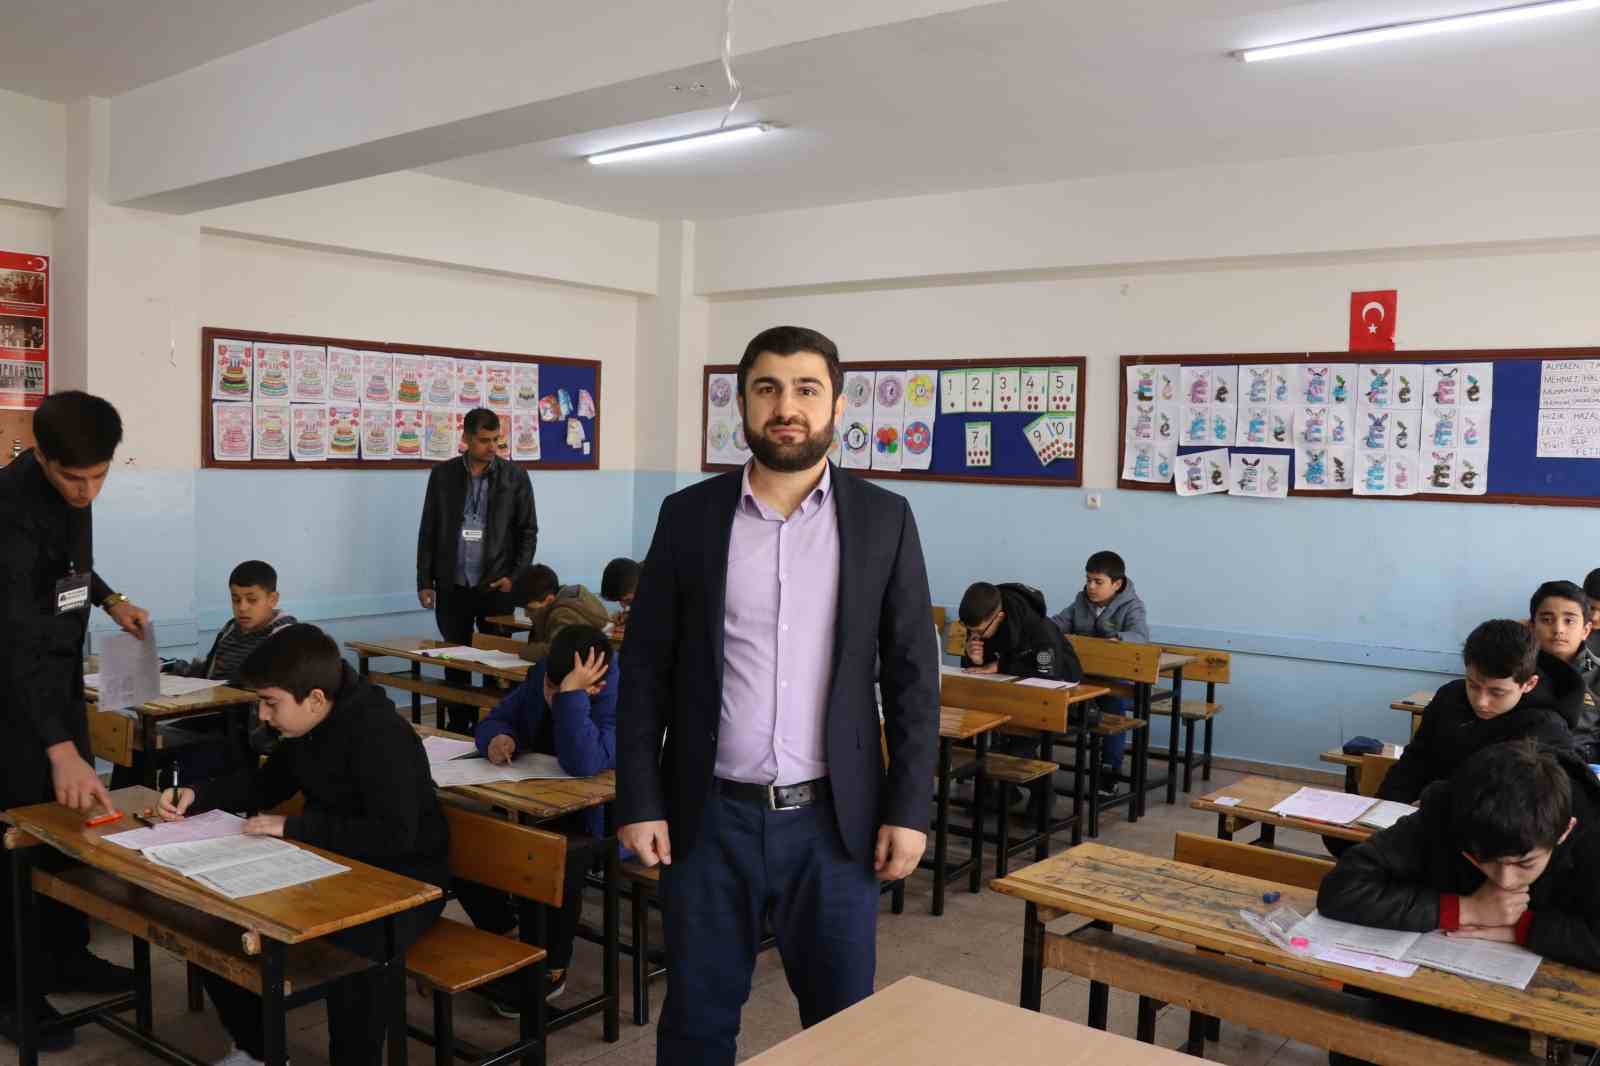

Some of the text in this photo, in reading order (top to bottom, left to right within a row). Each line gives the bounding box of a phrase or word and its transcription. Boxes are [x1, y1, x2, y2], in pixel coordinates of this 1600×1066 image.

[947, 375, 1065, 392] 1 2 3 4 5
[972, 431, 979, 446] 7
